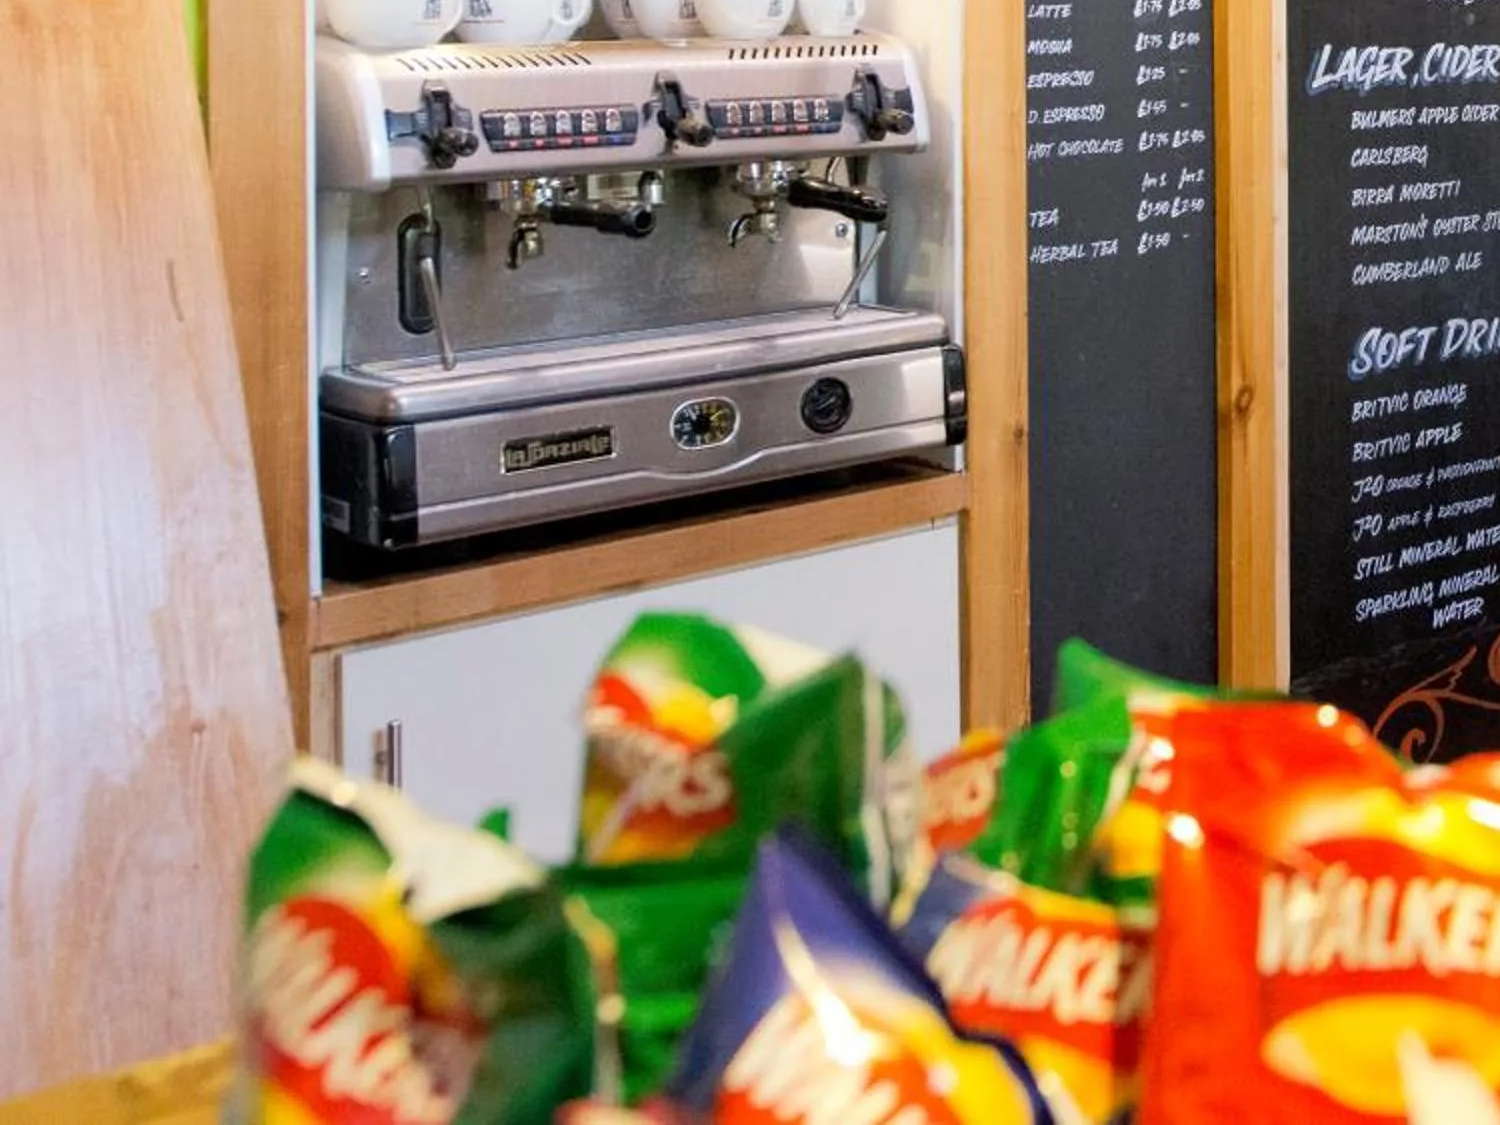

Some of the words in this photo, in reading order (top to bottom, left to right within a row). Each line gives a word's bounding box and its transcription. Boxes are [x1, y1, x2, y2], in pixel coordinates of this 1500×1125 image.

[1028, 4, 1073, 19] LATTE
[1028, 70, 1095, 88] ESPRESSO
[1351, 106, 1416, 130] BULMERS
[1417, 106, 1459, 124] APPLE
[1461, 104, 1500, 122] CIDER
[1028, 142, 1053, 160] HOT
[1058, 138, 1125, 157] CHOCOLATE
[1351, 145, 1429, 169] CARLSBERG
[1351, 184, 1395, 208] BIRRA
[1399, 179, 1462, 203] MORETTI
[1030, 208, 1059, 228] TEA
[1432, 213, 1481, 237] OYSTER
[1030, 244, 1086, 264] HERBAL
[1092, 238, 1119, 258] TEA
[1352, 255, 1451, 286] CUMBERLAND
[1455, 250, 1483, 272] ALE
[1348, 325, 1440, 381] SOFT
[1351, 393, 1411, 423] BRITVIC
[1413, 383, 1468, 411] ORANGE
[1352, 432, 1411, 463] BRITVIC
[1415, 422, 1464, 449] APPLE
[1387, 510, 1421, 532] APPLE
[1354, 553, 1395, 581] STILL
[1399, 536, 1463, 569] MINERAL
[1355, 581, 1434, 622] SPARKLING
[1438, 564, 1500, 598] MINERAL
[1433, 596, 1486, 629] WATER
